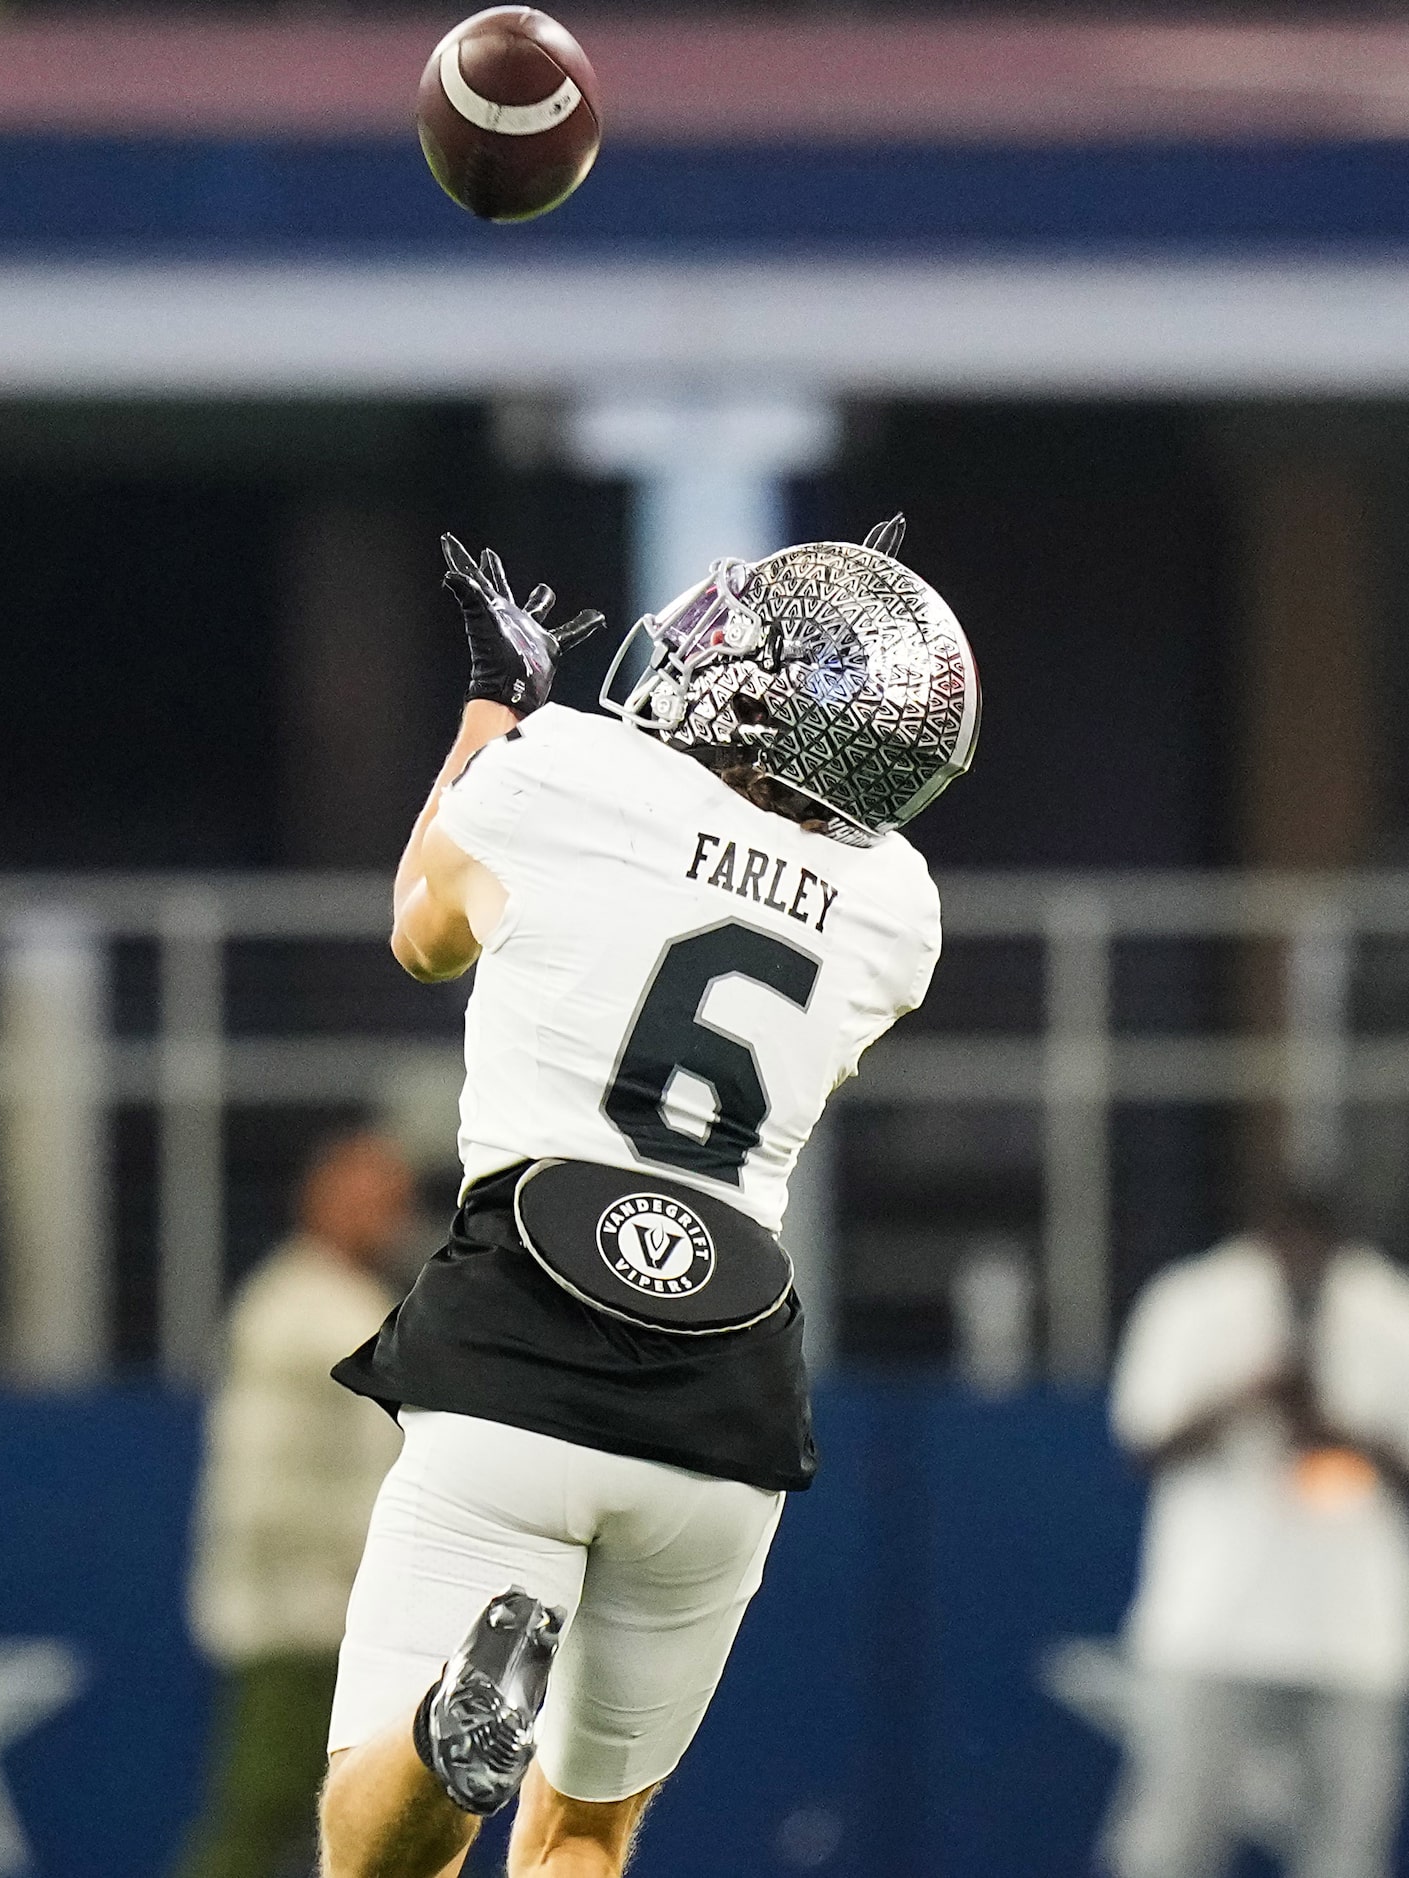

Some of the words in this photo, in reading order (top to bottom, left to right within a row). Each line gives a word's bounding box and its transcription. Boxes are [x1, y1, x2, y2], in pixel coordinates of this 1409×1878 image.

[685, 832, 839, 934] FARLEY
[598, 914, 824, 1193] 6
[602, 1197, 710, 1261] VANDEGRIFT
[614, 1257, 694, 1293] VIPERS
